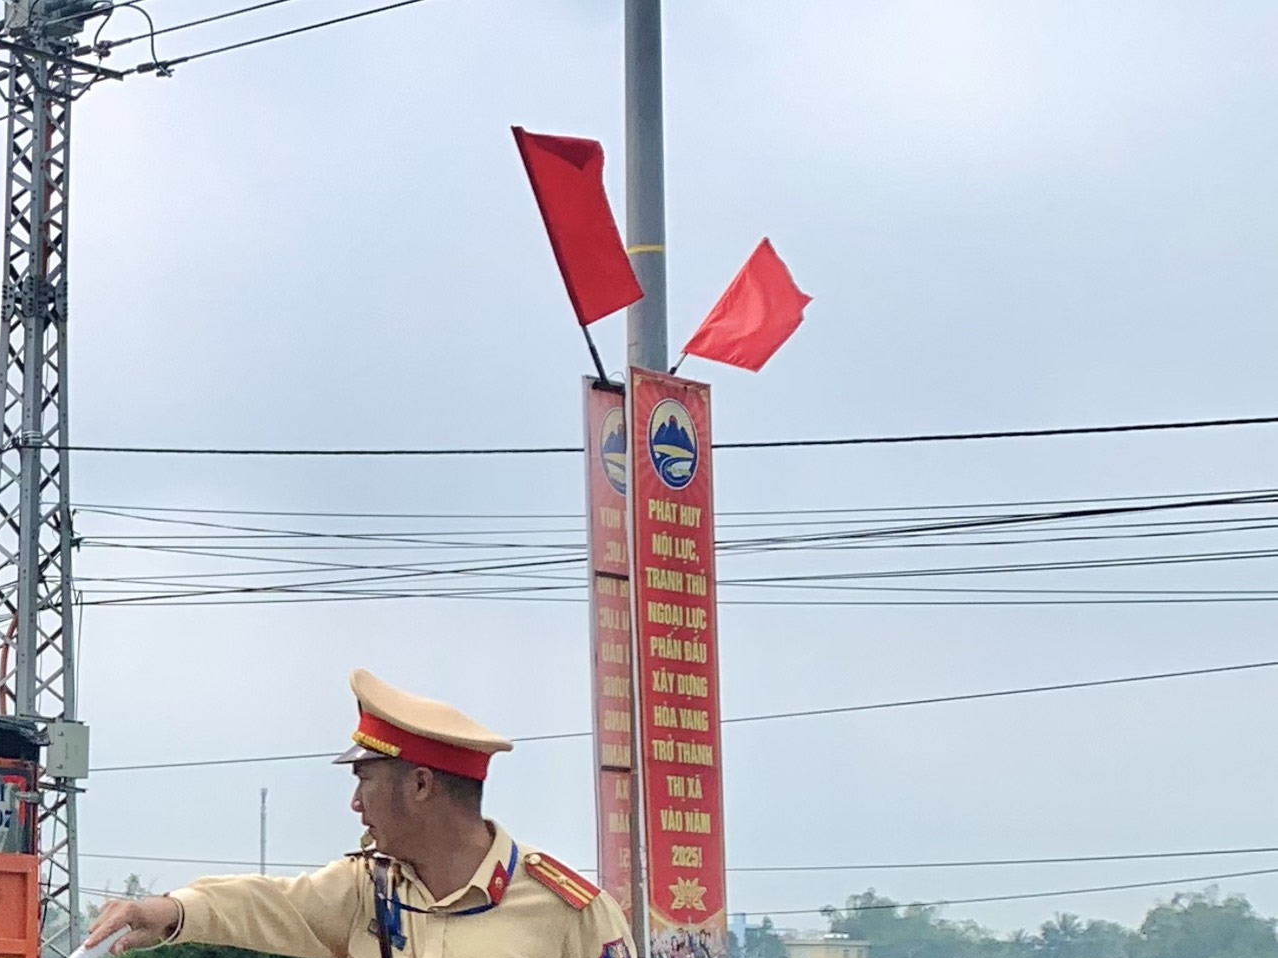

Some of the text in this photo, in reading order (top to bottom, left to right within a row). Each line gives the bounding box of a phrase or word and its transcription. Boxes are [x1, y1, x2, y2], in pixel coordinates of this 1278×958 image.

[648, 497, 702, 528] PHÁT HUY
[652, 531, 672, 561] NỘI
[645, 566, 683, 593] TRANH
[685, 569, 707, 596] THỦ
[647, 600, 683, 631] NGOẠI
[686, 606, 707, 634] LỰC
[650, 631, 682, 660] PHẤN
[652, 667, 708, 701] XÂY DỰNG
[653, 701, 709, 732] HÒA VANG
[652, 734, 713, 766] TRỞ THÀNH
[666, 774, 703, 802] THỊ XÃ
[660, 805, 711, 834] VÀO NĂM
[671, 845, 703, 869] 2025!
